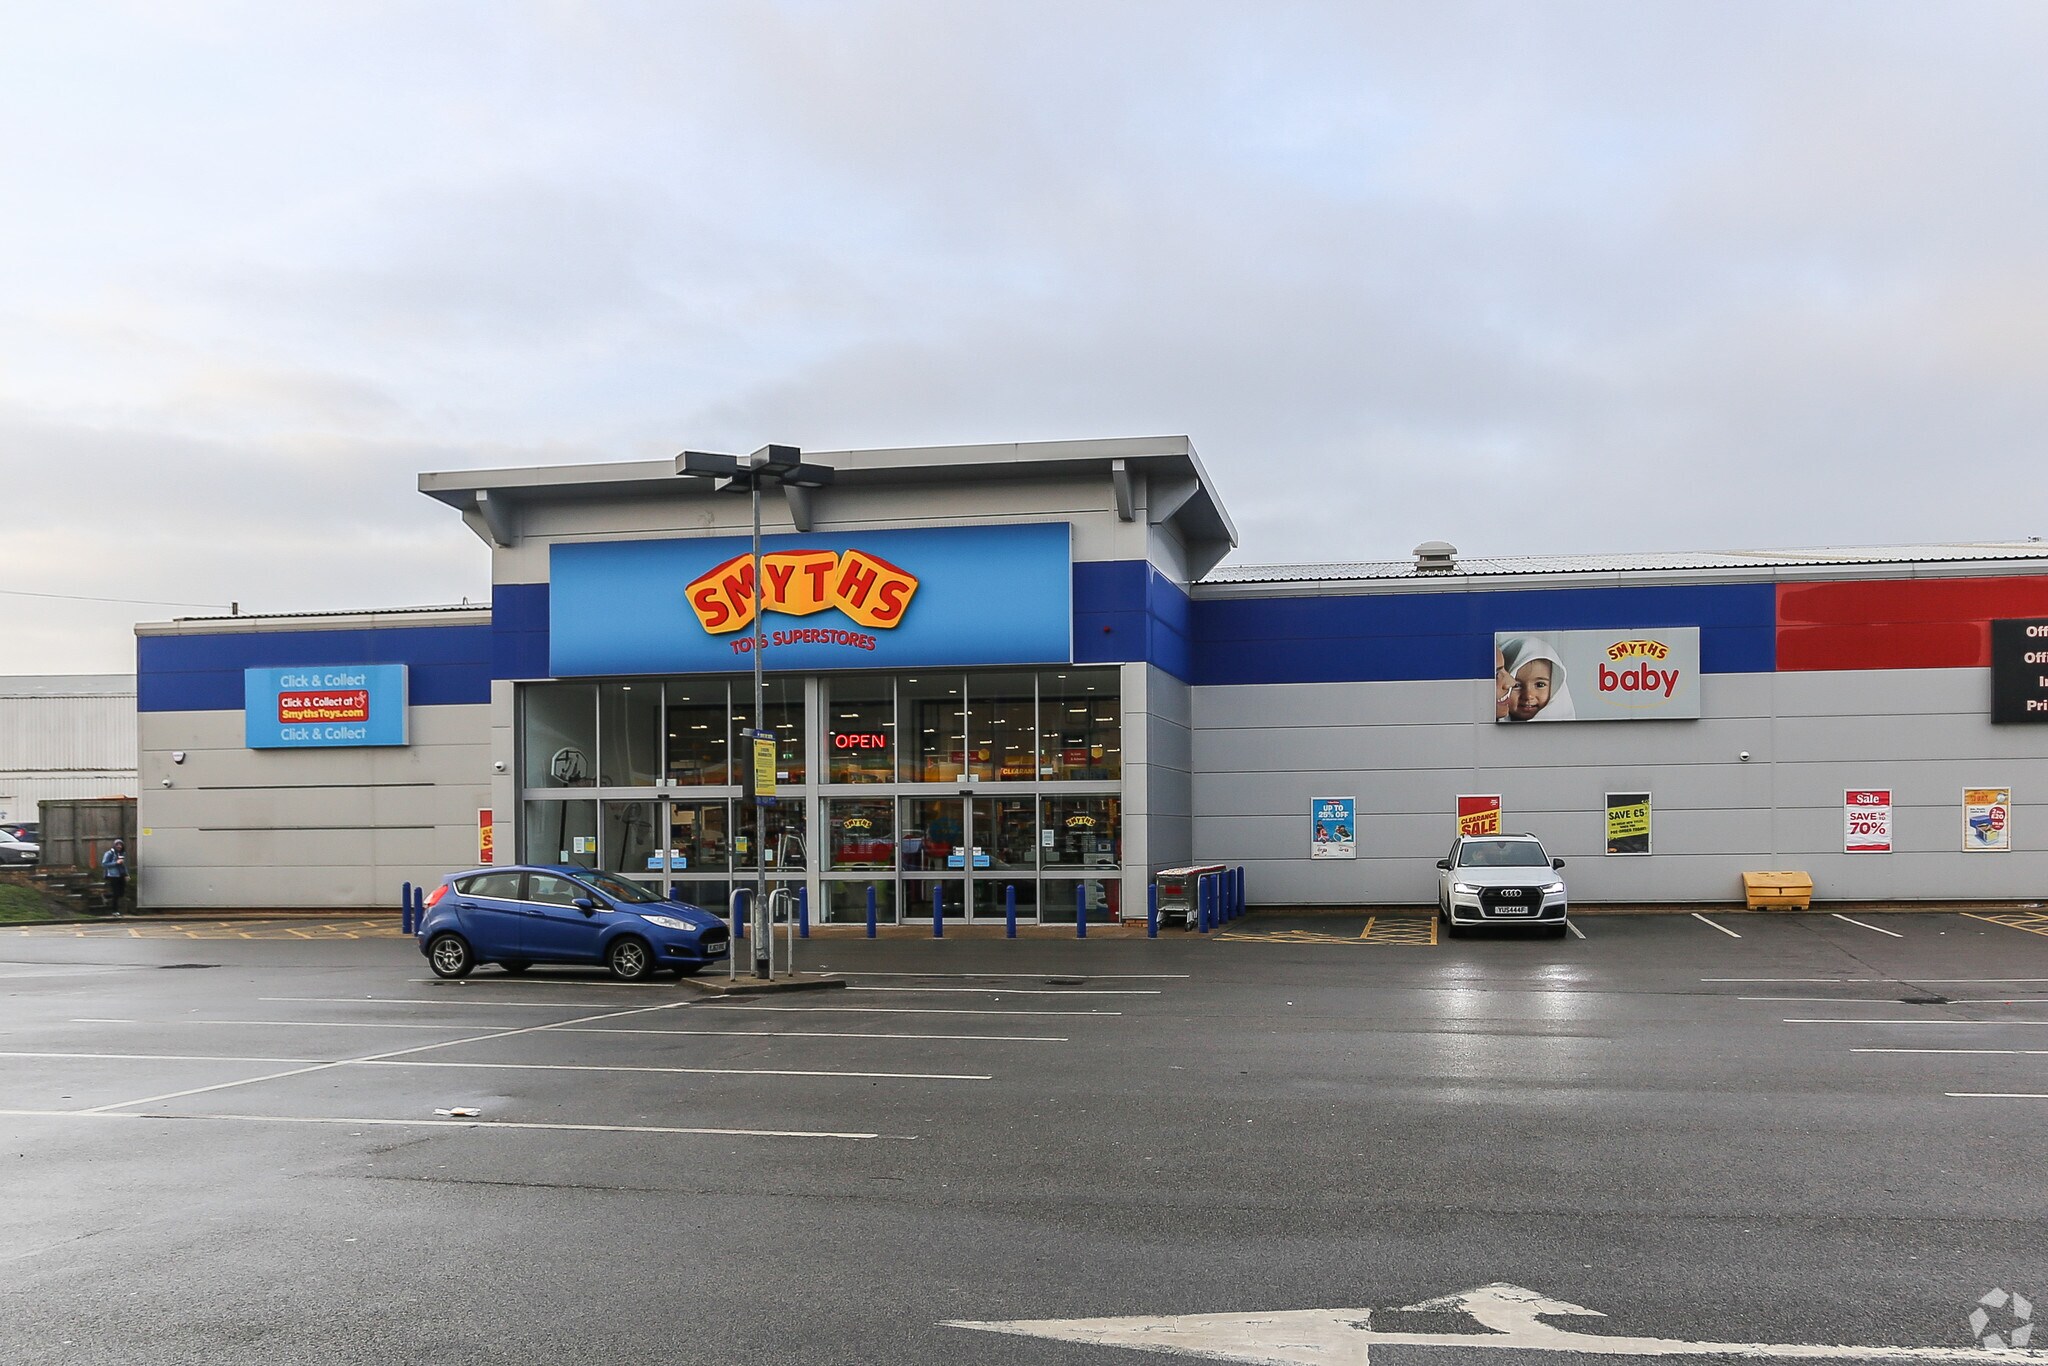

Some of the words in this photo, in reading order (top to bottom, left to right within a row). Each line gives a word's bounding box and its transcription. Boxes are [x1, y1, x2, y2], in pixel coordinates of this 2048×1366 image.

[694, 559, 910, 627] SMYTHS
[730, 634, 768, 655] TOYS
[773, 628, 877, 651] SUPERSTORES
[1608, 643, 1668, 660] SMYTHS
[280, 675, 308, 687] Click
[312, 675, 321, 686] &
[324, 673, 367, 686] Collect
[1599, 662, 1679, 698] baby
[281, 698, 302, 707] Click
[303, 698, 311, 707] &
[313, 697, 342, 706] Collect
[343, 697, 353, 706] at
[282, 709, 364, 719] SmythsToys.com
[281, 728, 309, 740] Click
[312, 728, 321, 740] &
[325, 727, 367, 739] Collect
[835, 734, 884, 748] OPEN
[1856, 794, 1880, 804] Sale
[1461, 812, 1497, 825] CLEARANCE
[1609, 810, 1631, 820] SAVE
[1633, 809, 1645, 817] £5
[1850, 812, 1877, 820] SAVE
[1066, 816, 1096, 827] SMYTHS
[1461, 819, 1497, 835] SALE
[1850, 822, 1885, 834] 70%
